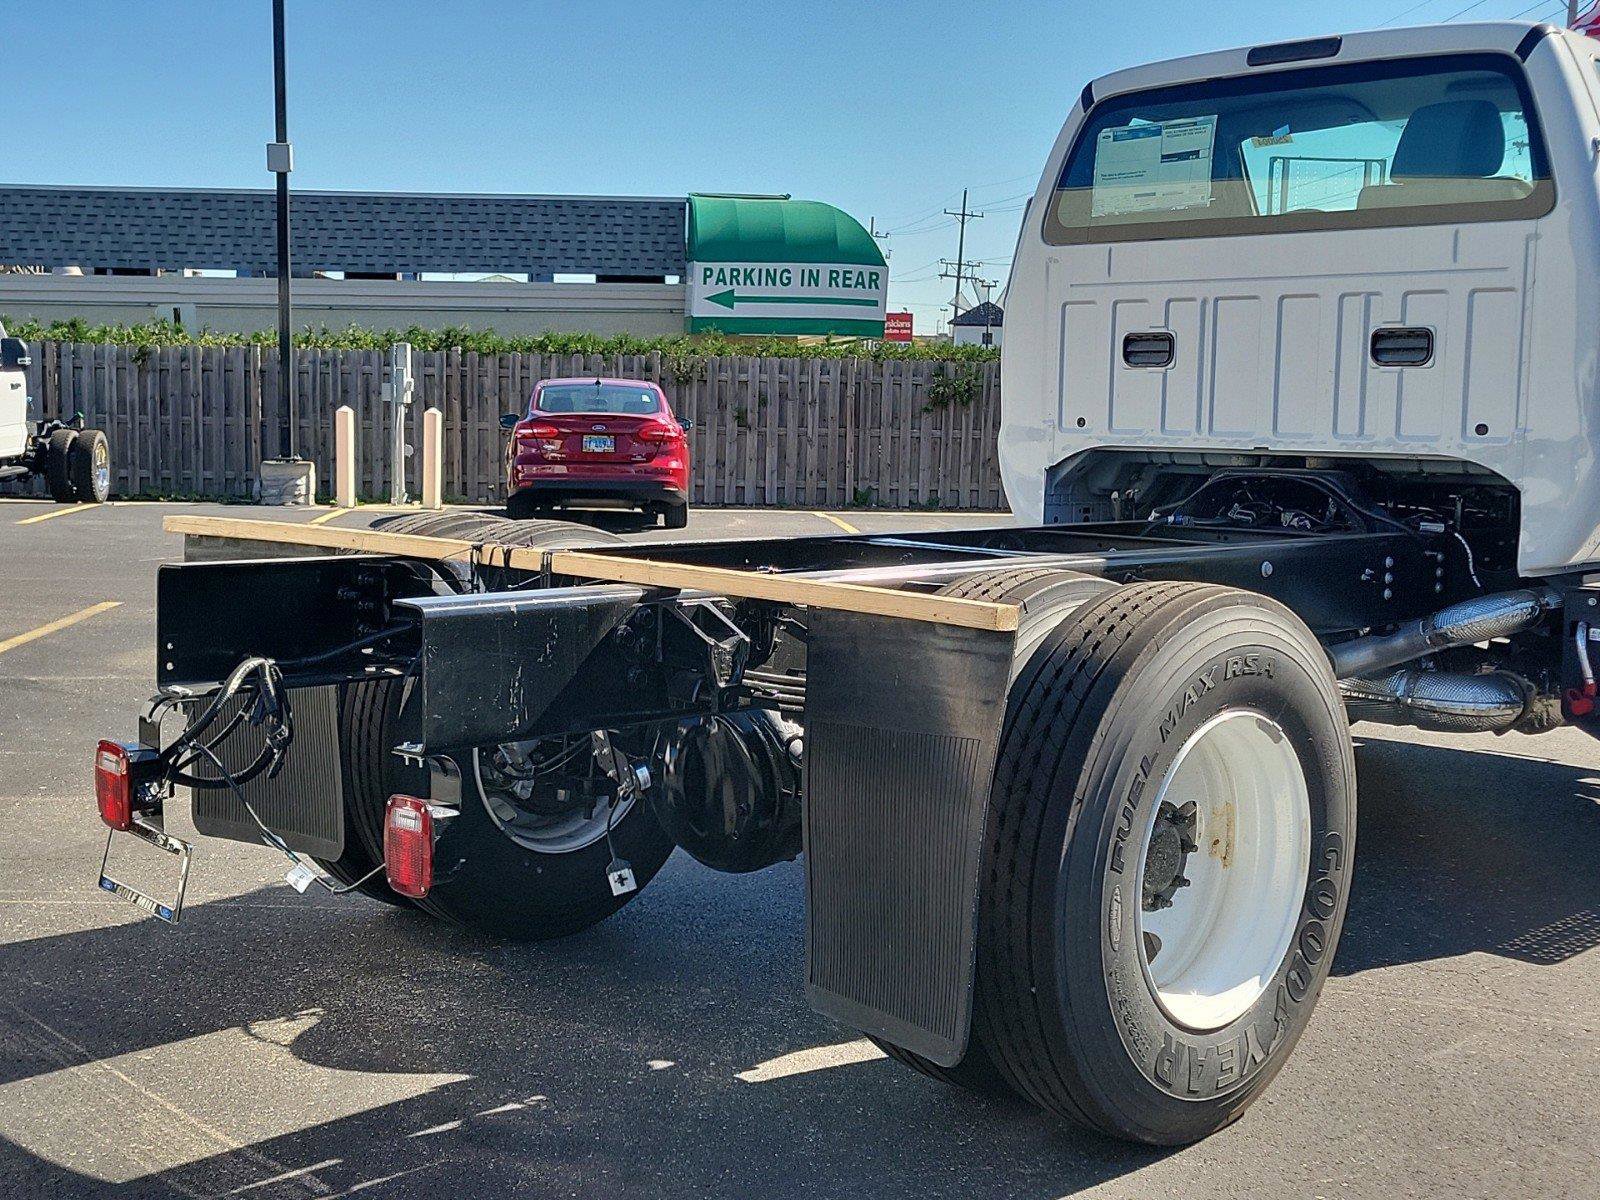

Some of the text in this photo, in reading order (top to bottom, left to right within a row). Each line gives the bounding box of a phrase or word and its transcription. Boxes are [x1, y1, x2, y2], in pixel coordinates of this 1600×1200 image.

[702, 267, 881, 290] PARKING IN REAR
[1110, 653, 1277, 875] FUEL MAX RSA
